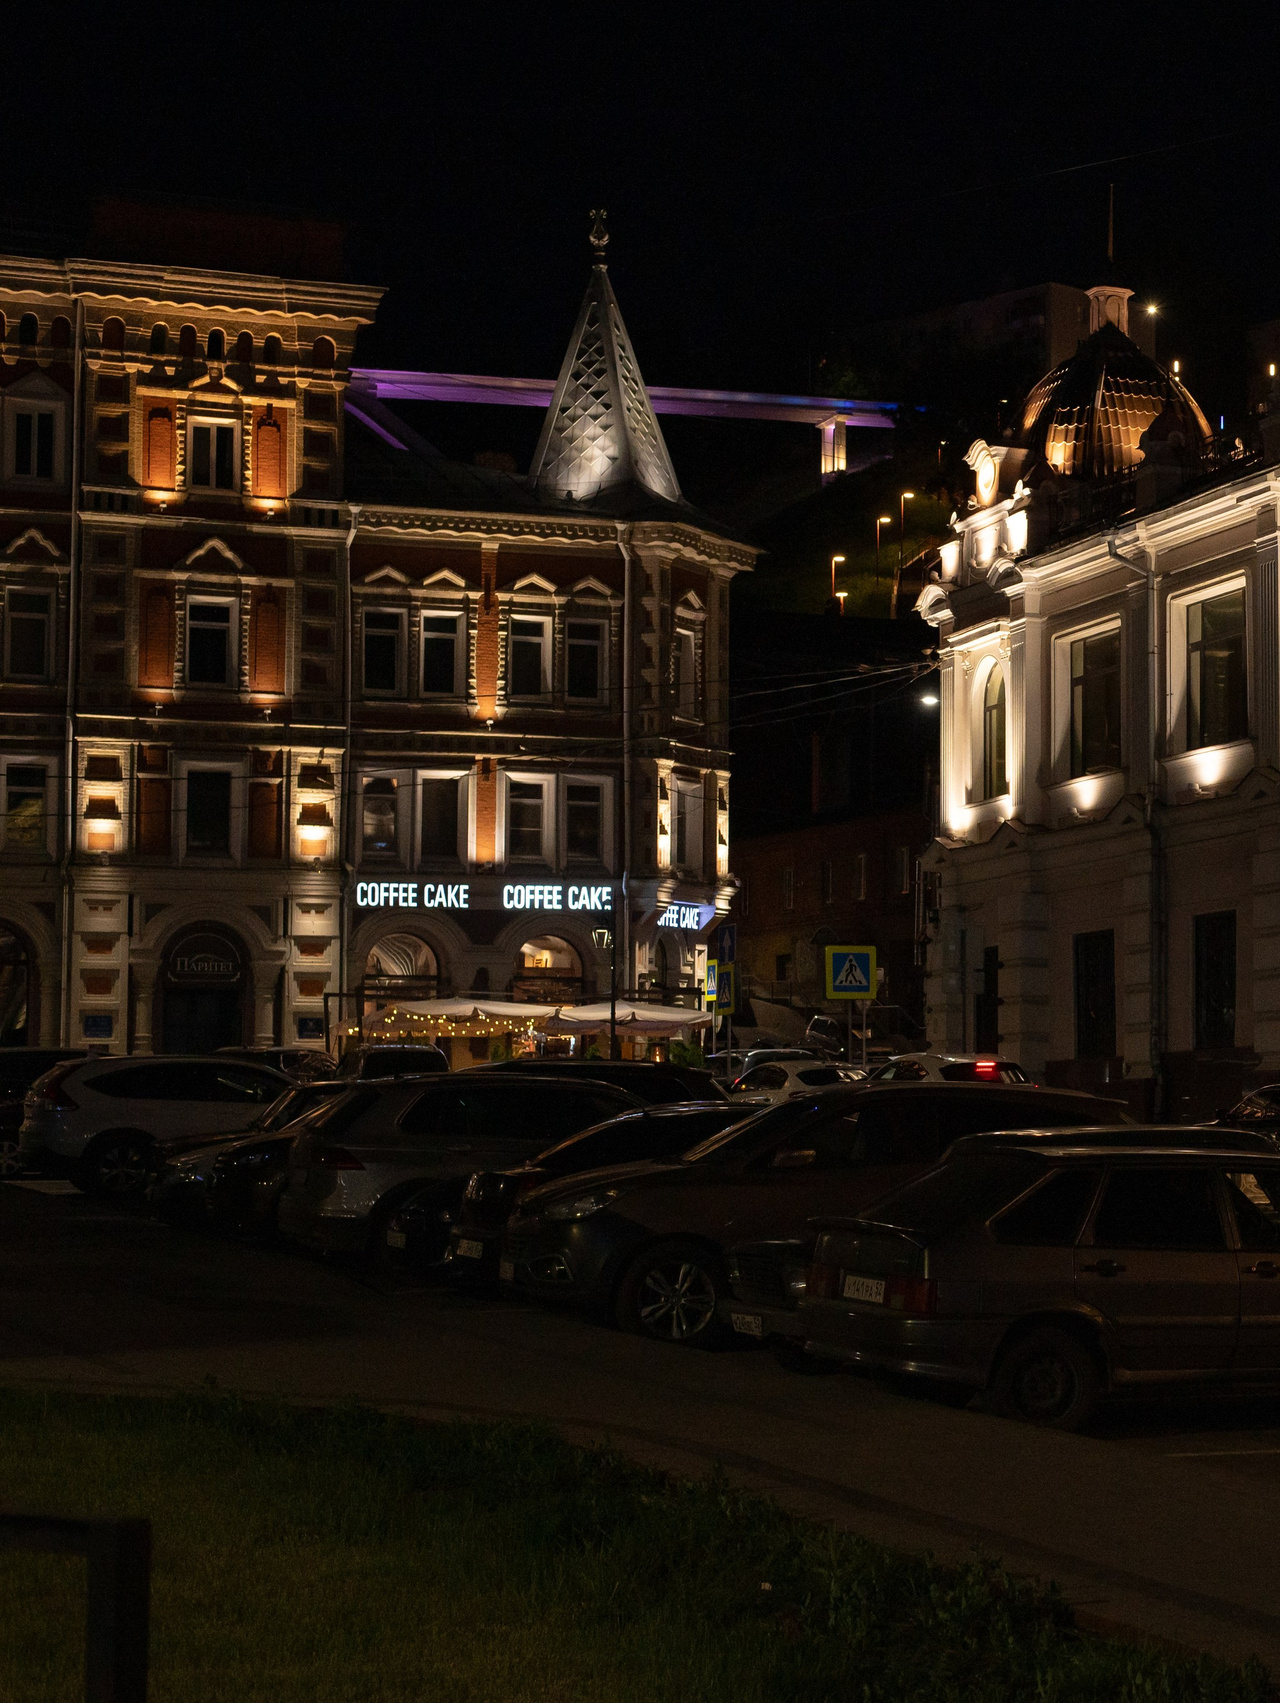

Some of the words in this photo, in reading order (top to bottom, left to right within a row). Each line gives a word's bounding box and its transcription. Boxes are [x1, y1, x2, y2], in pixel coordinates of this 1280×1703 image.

[356, 882, 418, 908] COFFEE
[423, 884, 469, 909] CAKE
[502, 885, 562, 910] COFFEE
[568, 886, 612, 910] CAKE
[680, 906, 700, 930] CAKE
